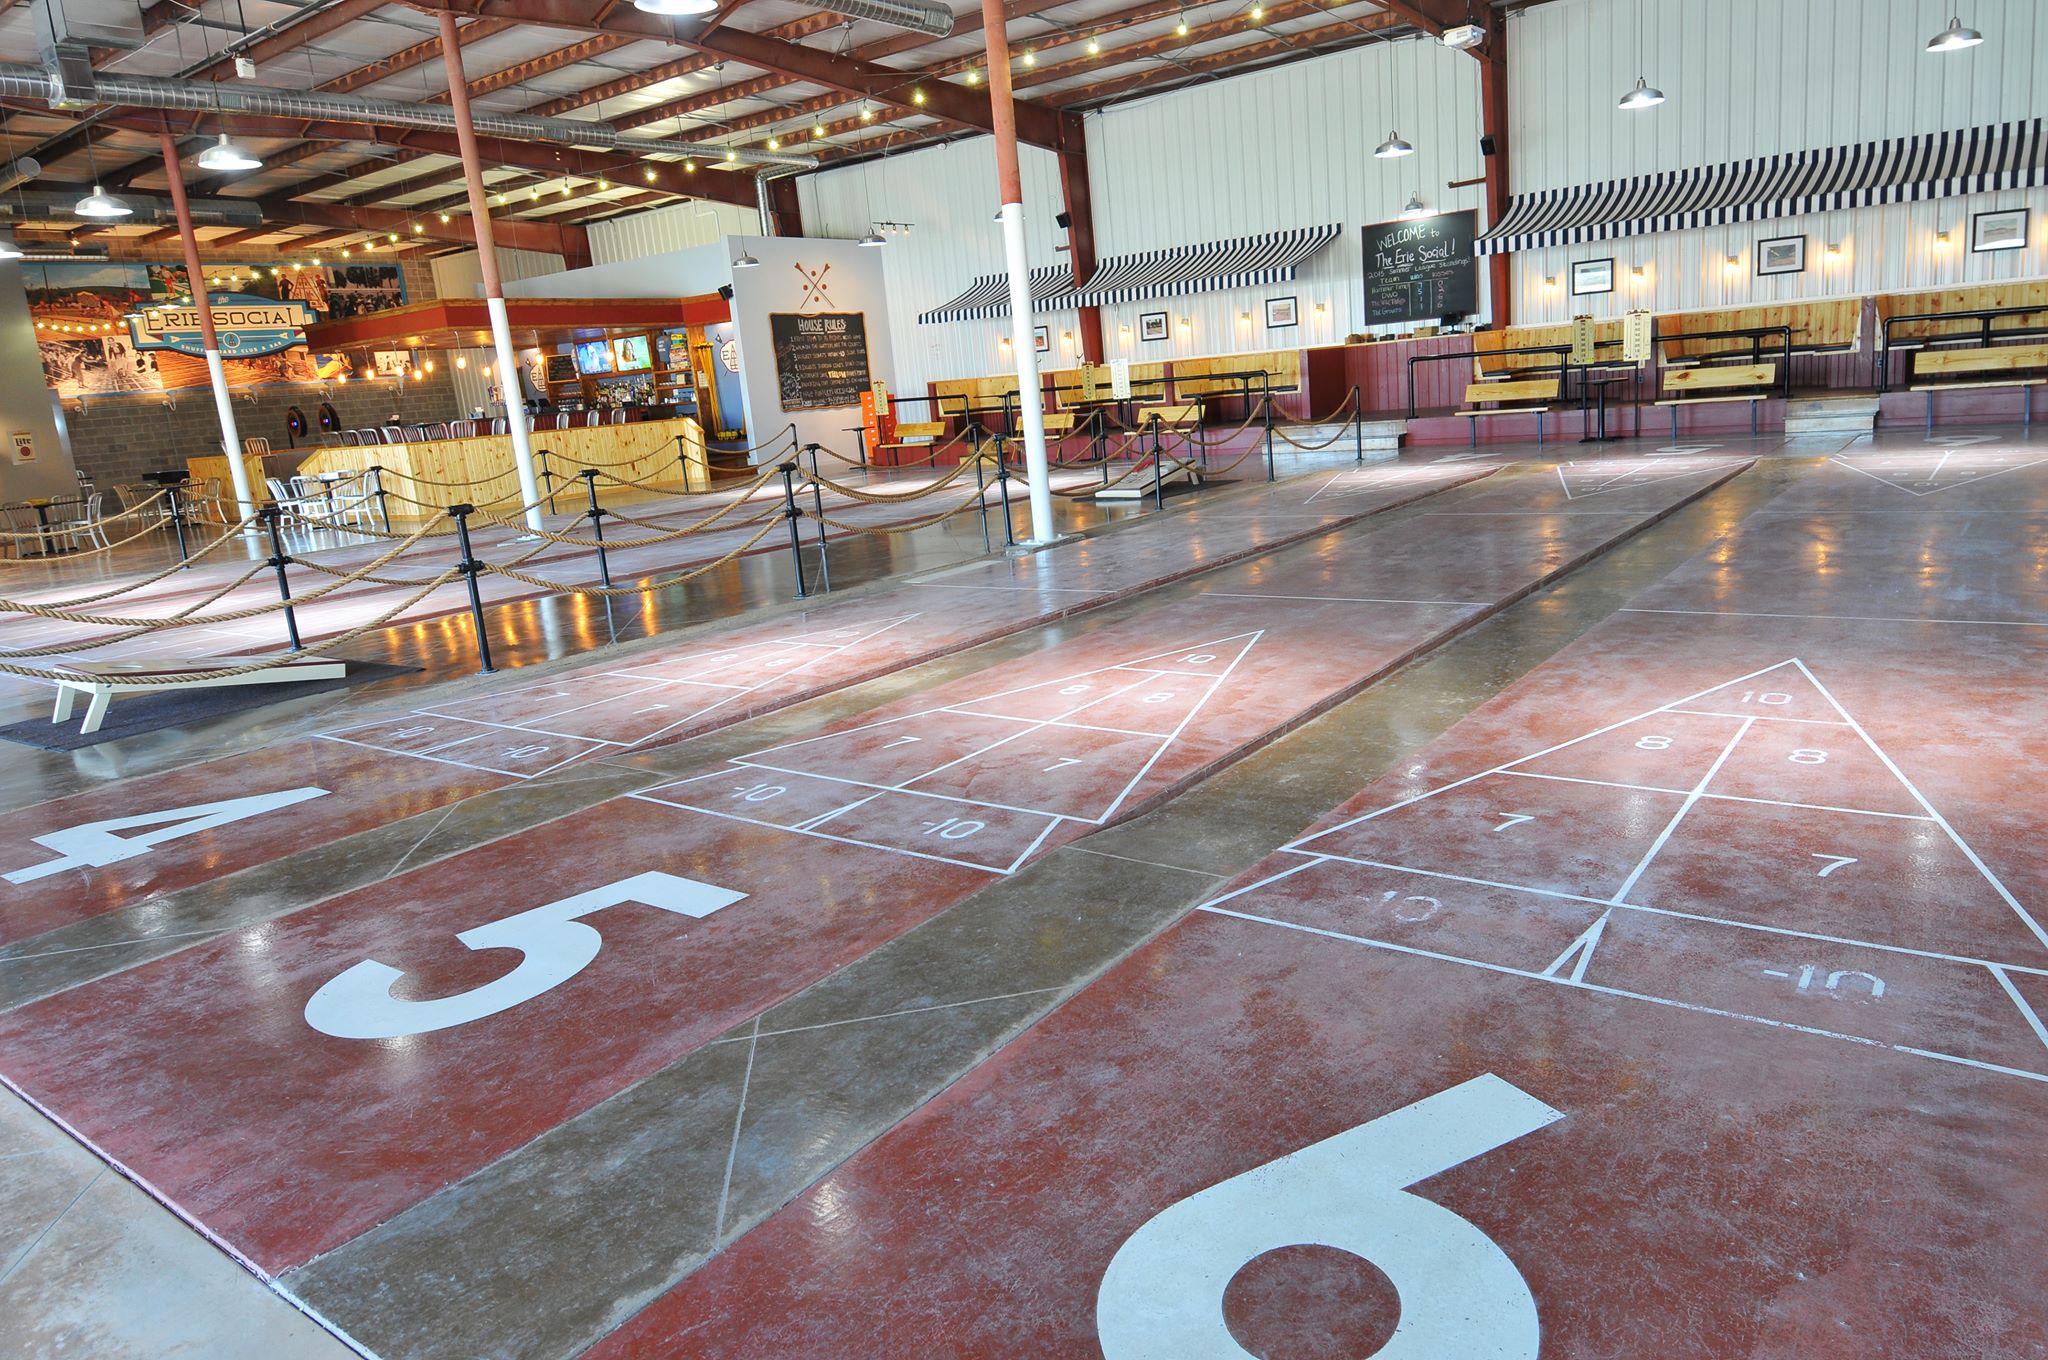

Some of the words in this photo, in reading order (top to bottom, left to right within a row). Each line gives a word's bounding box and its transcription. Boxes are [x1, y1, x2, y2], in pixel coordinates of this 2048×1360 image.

[1376, 224, 1426, 251] WELCOME
[1430, 228, 1440, 238] to
[1375, 252, 1393, 268] The
[1395, 248, 1415, 265] Erie
[1368, 270, 1385, 279] 2015
[1415, 263, 1436, 273] League
[217, 295, 230, 305] the
[212, 307, 305, 328] SOCIAL
[798, 319, 824, 332] HOUSE
[824, 318, 847, 332] RULES
[15, 437, 31, 447] Lite
[1176, 653, 1217, 664] 10
[1059, 684, 1091, 695] 8
[1143, 692, 1175, 704] 8
[1741, 691, 1793, 705] 10
[883, 735, 922, 749] 7
[1634, 735, 1674, 750] 8
[1788, 748, 1829, 764] 8
[1042, 757, 1083, 772] 7
[731, 783, 787, 802] -10
[922, 817, 986, 839] -10
[1493, 812, 1535, 832] 7
[0, 786, 332, 885] 4
[1811, 853, 1858, 878] 7
[304, 870, 750, 1040] 5
[1097, 1072, 1567, 1360] 6
